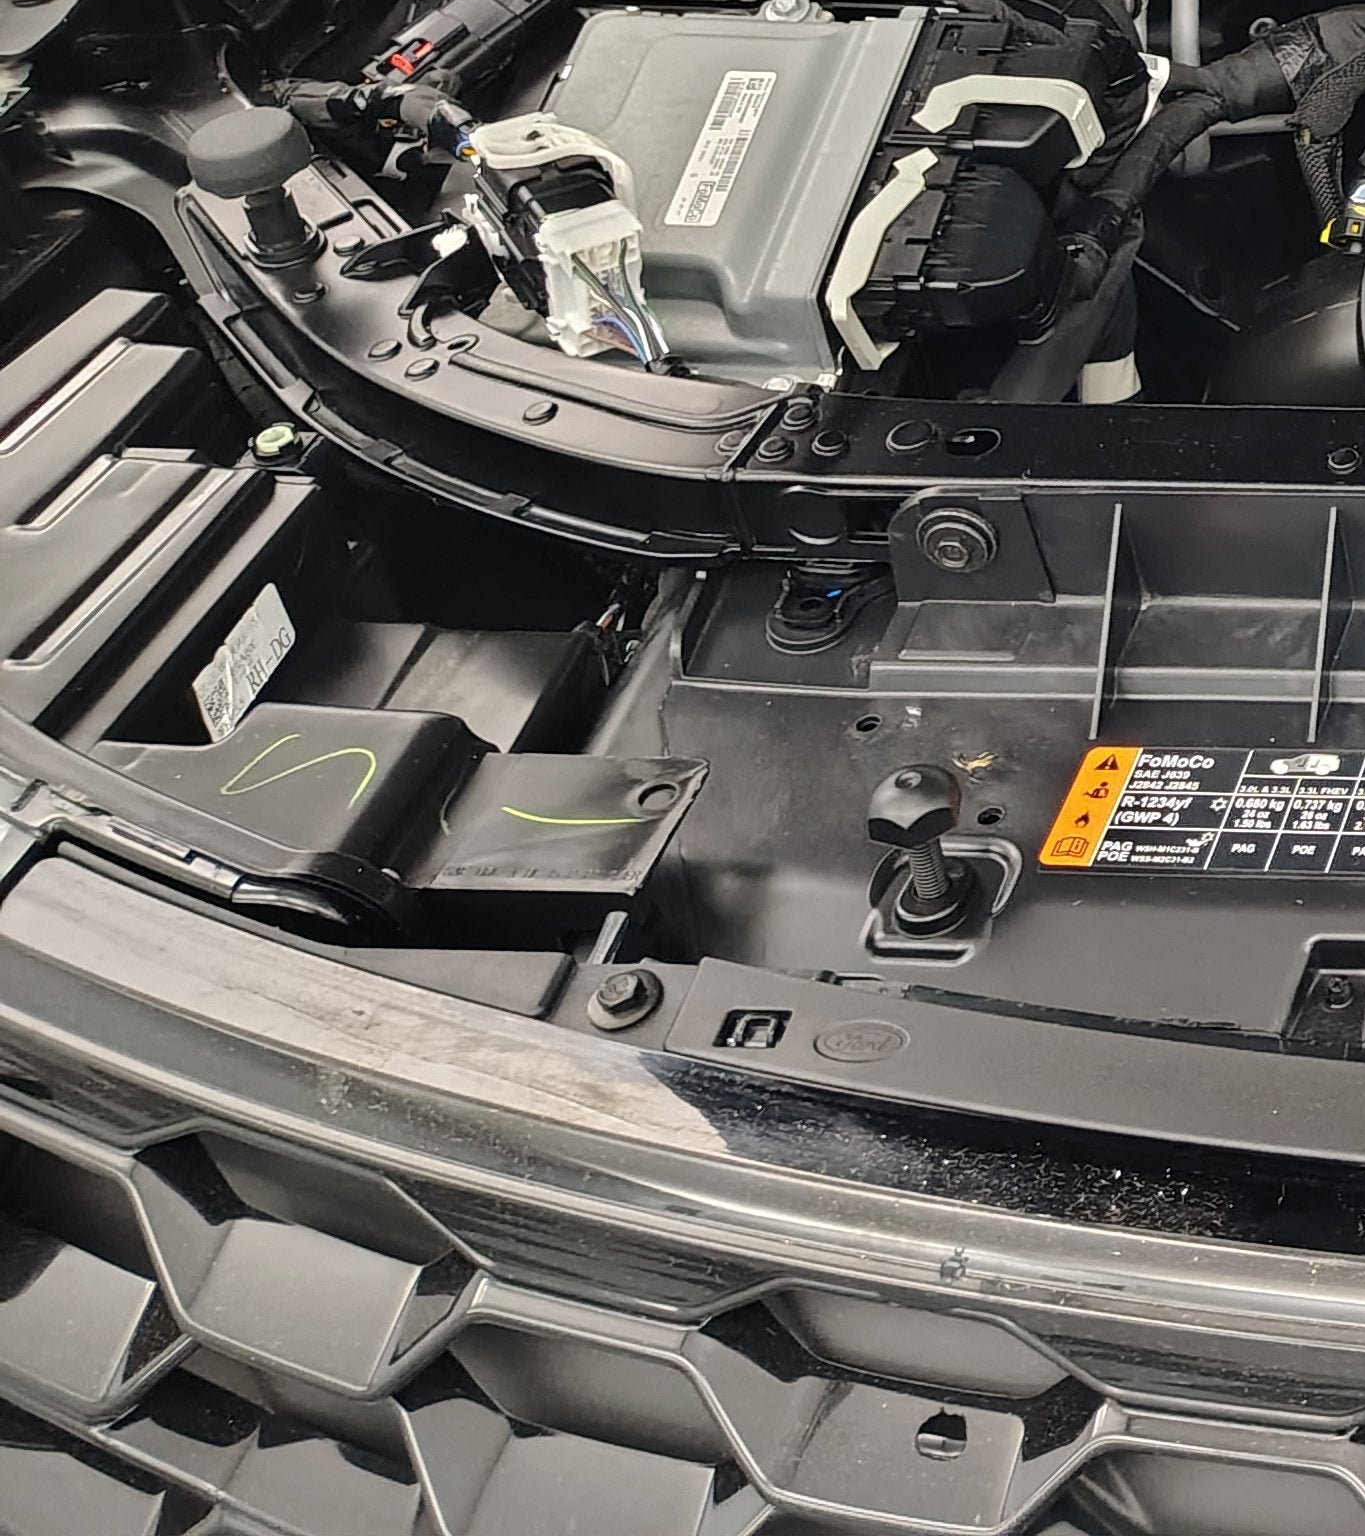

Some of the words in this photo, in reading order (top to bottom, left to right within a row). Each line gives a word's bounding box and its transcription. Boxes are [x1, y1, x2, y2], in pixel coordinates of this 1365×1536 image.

[1137, 754, 1215, 769] FoMoCo
[1134, 770, 1160, 779] SAE
[1128, 781, 1164, 790] J2842
[1121, 795, 1194, 811] R-1234yf
[1268, 798, 1285, 812] kg
[1292, 799, 1326, 810] 0.737
[1326, 800, 1343, 813] kg
[1114, 811, 1162, 825] (GWP
[1162, 812, 1180, 826] 4)
[1241, 810, 1256, 819] 24
[1256, 811, 1270, 819] oz
[1315, 812, 1328, 821] oz
[1254, 819, 1272, 829] lbs
[1313, 821, 1331, 830] lbs
[1101, 840, 1133, 852] PAG
[1230, 843, 1256, 853] PAG
[1291, 844, 1317, 855] POE
[1097, 851, 1131, 862] POE
